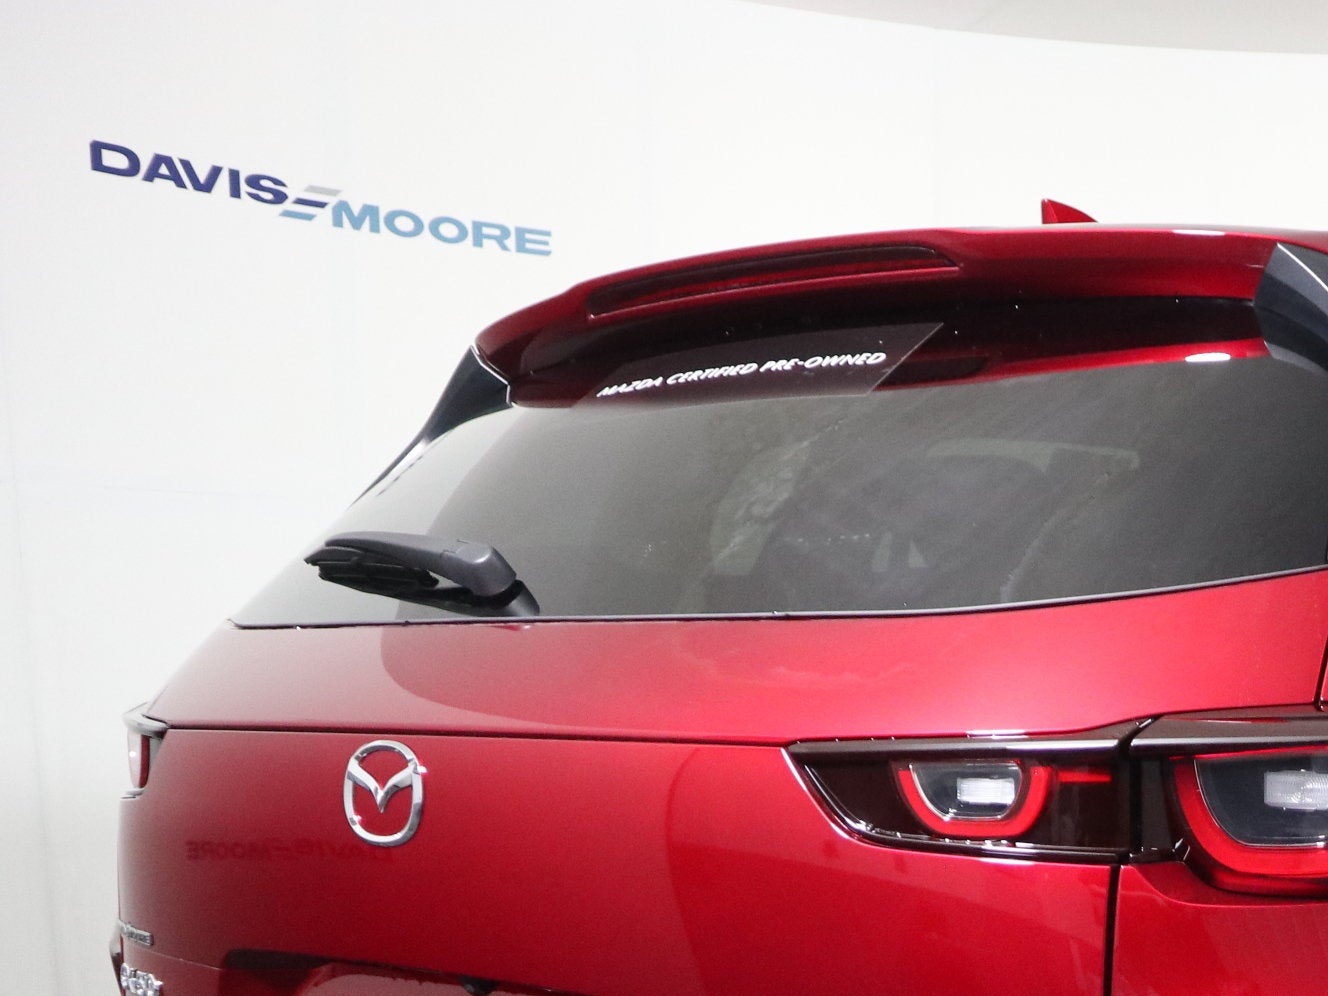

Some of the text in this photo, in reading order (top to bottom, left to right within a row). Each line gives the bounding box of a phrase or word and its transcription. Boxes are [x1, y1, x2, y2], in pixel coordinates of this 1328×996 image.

[89, 139, 552, 256] DAVIS MOORE
[596, 351, 887, 398] MAZDA CERTIFIED PRE-OWNED
